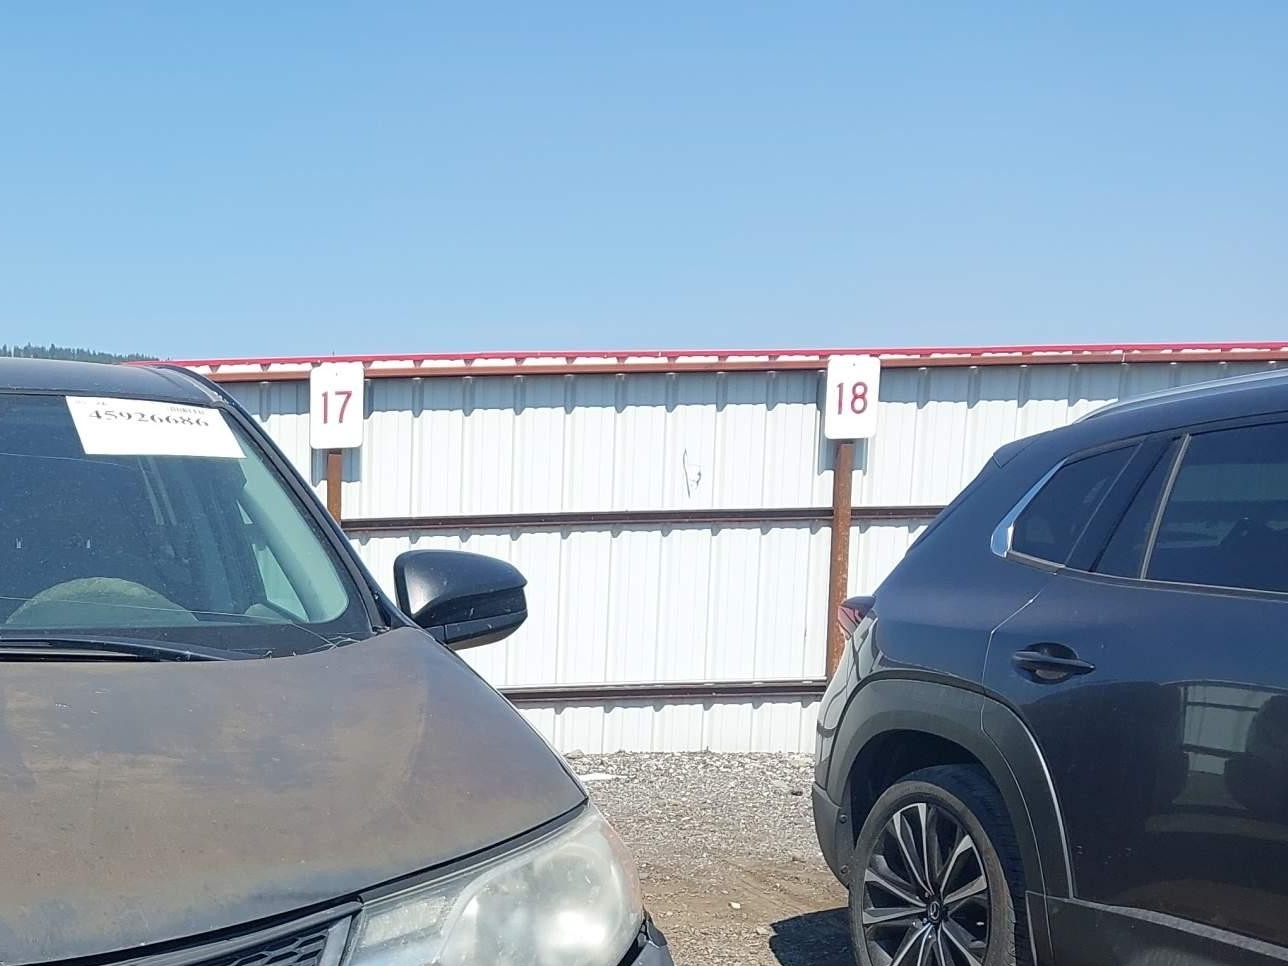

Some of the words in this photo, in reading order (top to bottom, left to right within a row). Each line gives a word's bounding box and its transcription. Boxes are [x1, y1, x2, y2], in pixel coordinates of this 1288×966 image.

[321, 391, 353, 425] 17
[837, 381, 869, 416] 18
[89, 409, 210, 428] 45926686
